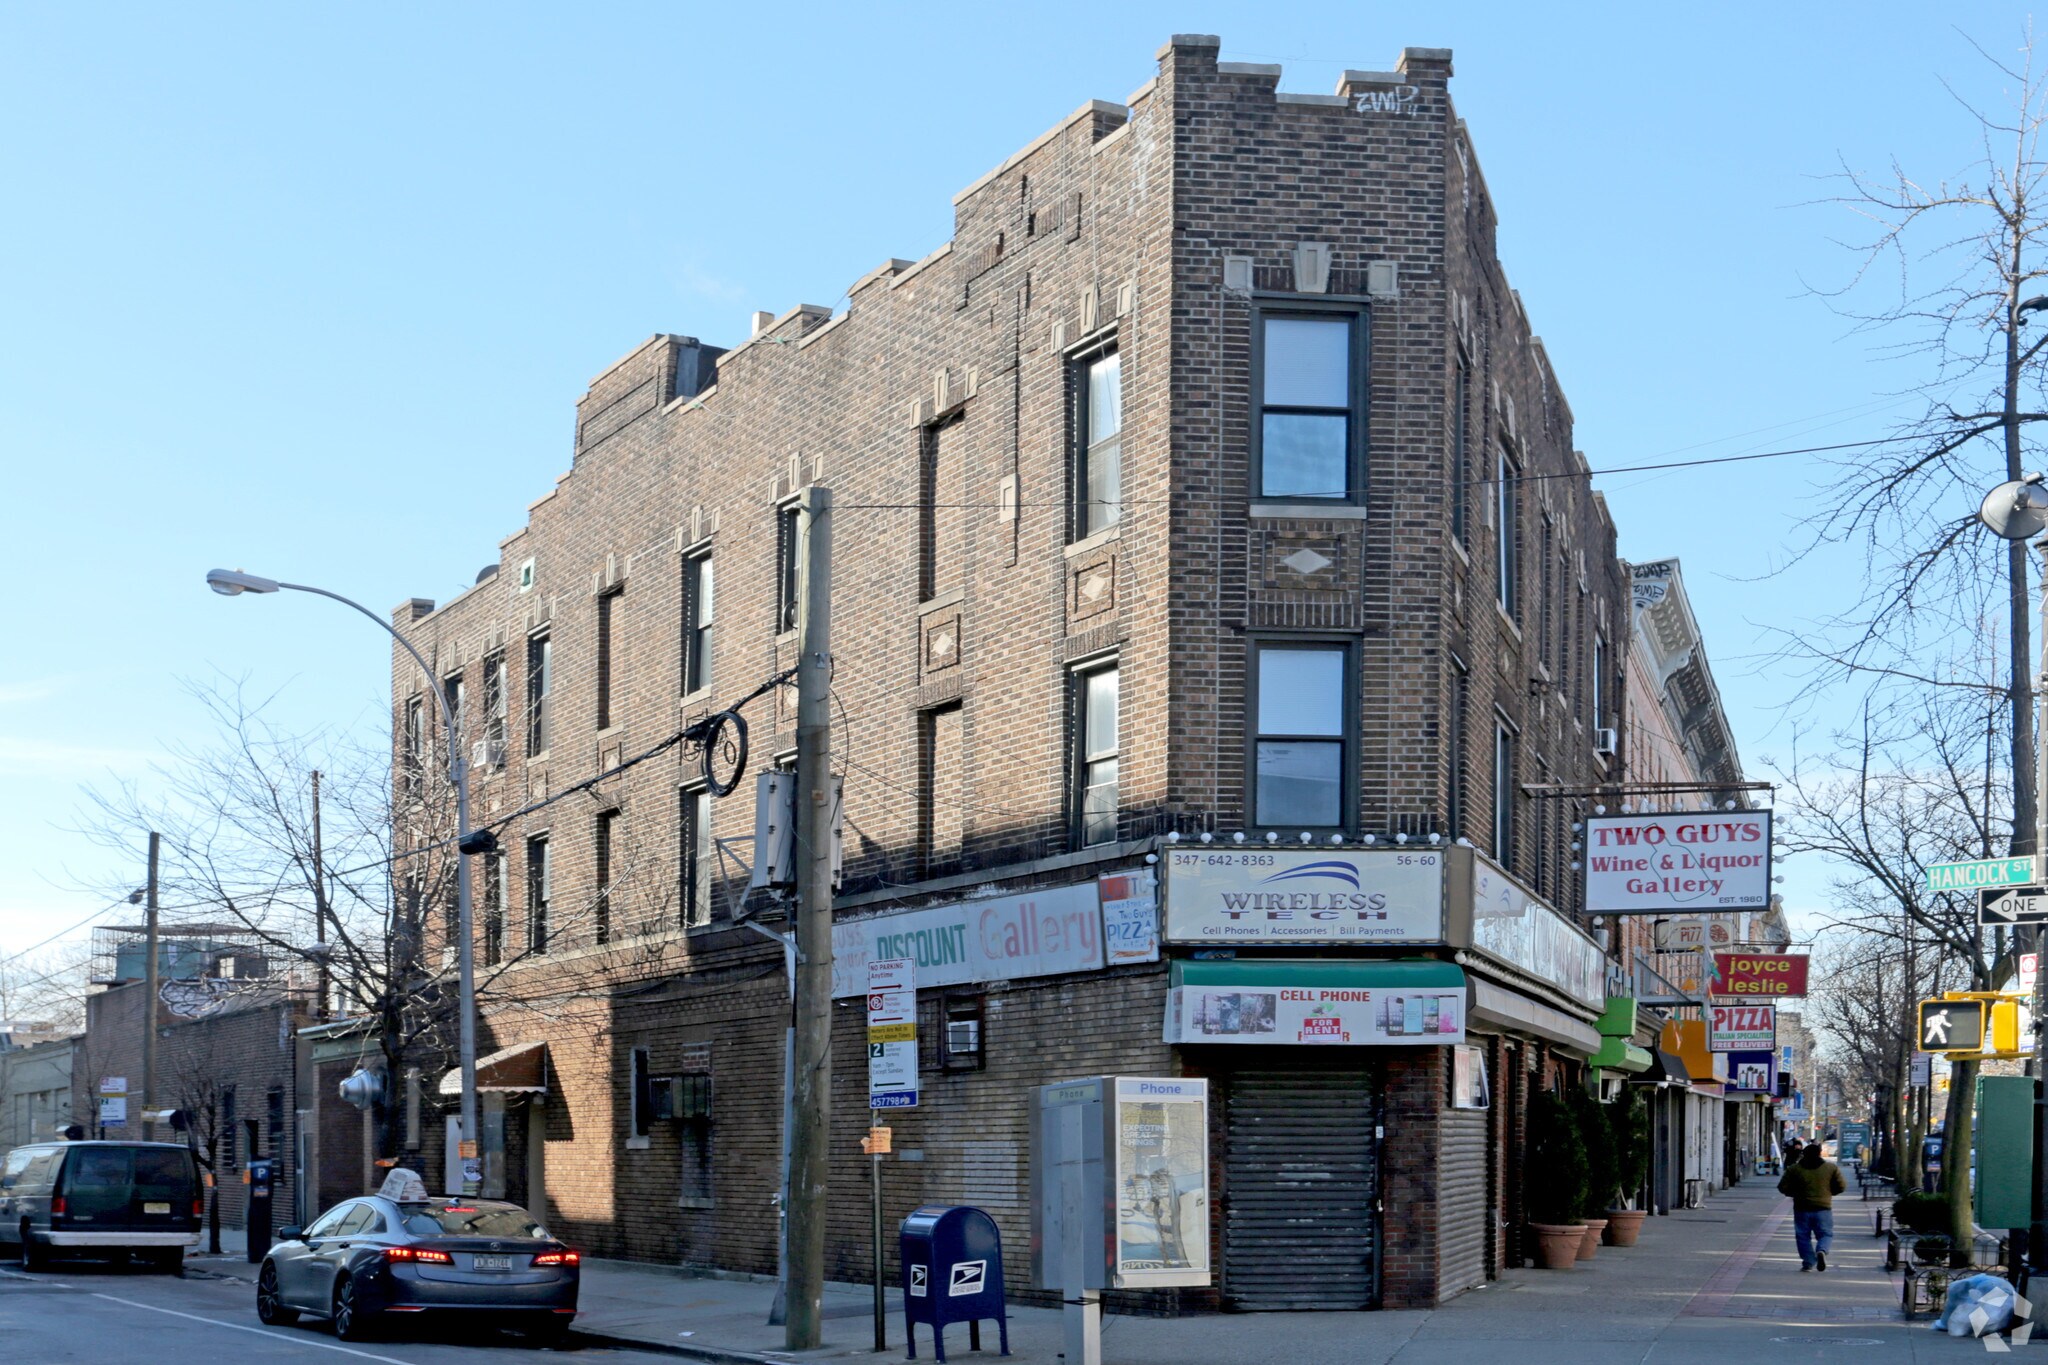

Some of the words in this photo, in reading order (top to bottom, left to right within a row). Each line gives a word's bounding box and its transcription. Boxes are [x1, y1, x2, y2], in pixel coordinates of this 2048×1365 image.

[1594, 825, 1666, 846] TWO
[1676, 823, 1761, 843] GUYS
[1175, 855, 1274, 866] 347-642-8363
[1397, 855, 1436, 866] 56-60
[1591, 855, 1648, 872] Wine
[1660, 854, 1674, 870] &
[1682, 852, 1763, 873] Liquor
[1930, 862, 2010, 888] HANCOCK
[2013, 859, 2030, 872] ST
[1626, 876, 1724, 895] Gallery
[1221, 892, 1386, 910] WIRELESS
[1739, 896, 1763, 904] 1980
[2001, 898, 2037, 913] ONE
[1221, 911, 1387, 921] TECH
[980, 902, 1098, 964] Gallery
[1202, 926, 1222, 935] Cell
[1224, 926, 1260, 935] Phones
[1271, 926, 1327, 935] Accessories
[1340, 926, 1356, 935] Bill
[1358, 926, 1405, 937] Payments
[1680, 926, 1703, 942] PIZZ
[877, 924, 966, 967] DISCOUNT
[1728, 957, 1791, 976] joyce
[1728, 977, 1789, 993] leslie
[1280, 990, 1316, 1002] CELL
[1321, 991, 1370, 1002] PHONE
[1714, 1008, 1772, 1031] PIZZA
[1305, 1026, 1340, 1034] RENT
[873, 1043, 881, 1056] 2
[1713, 1041, 1731, 1049] FREE
[1734, 1041, 1773, 1049] DELIVERY
[1059, 1090, 1084, 1099] Phone
[1140, 1084, 1182, 1094] Phone
[1931, 1145, 1939, 1154] P
[257, 1168, 266, 1179] P
